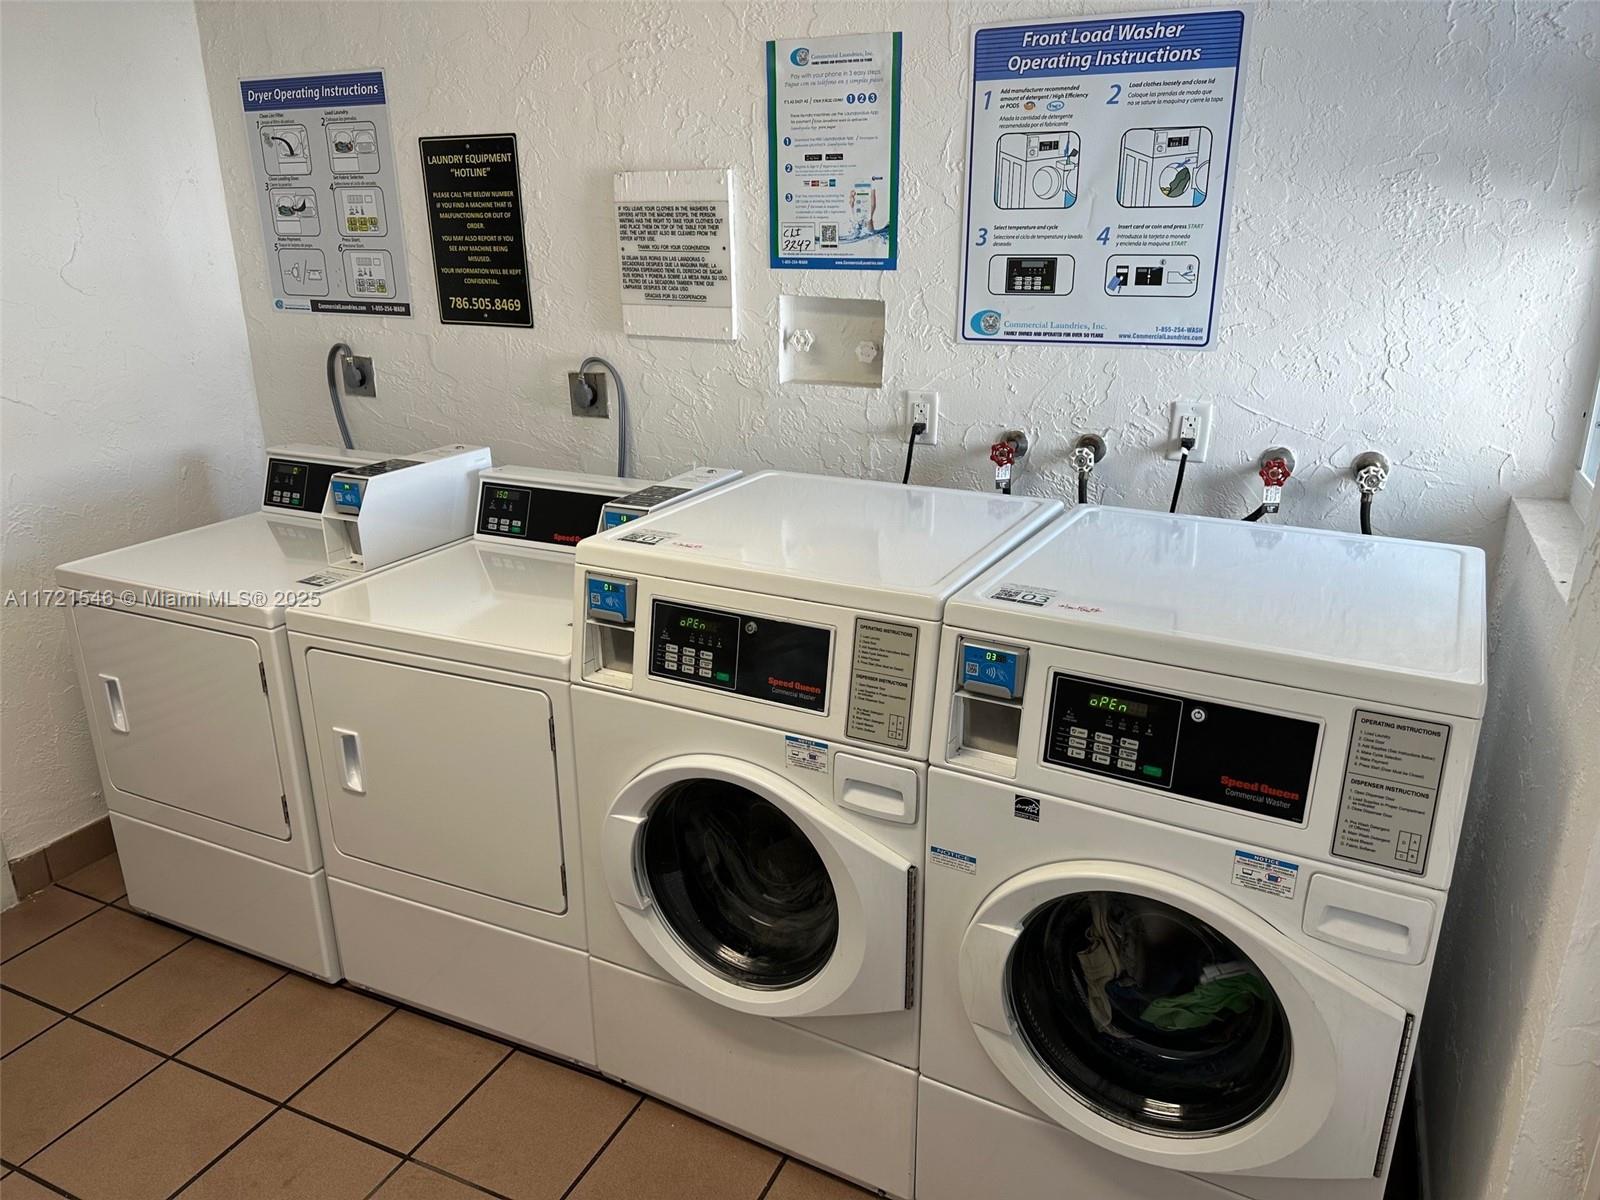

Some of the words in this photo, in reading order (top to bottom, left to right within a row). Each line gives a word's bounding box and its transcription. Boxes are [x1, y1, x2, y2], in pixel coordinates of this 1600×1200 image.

[1022, 31, 1067, 47] Front
[1071, 28, 1112, 44] Load
[1117, 23, 1183, 42] Washer
[1007, 52, 1091, 74] Operating
[1095, 46, 1200, 66] Instructions
[1011, 86, 1043, 94] manufacturer
[1044, 84, 1080, 92] recommended
[1162, 80, 1181, 88] loosely
[248, 89, 272, 105] Dryer
[273, 86, 320, 102] Operating
[321, 83, 378, 97] Instructions
[1065, 92, 1088, 100] Efficiency
[1105, 83, 1122, 104] 2
[984, 90, 992, 110] 1
[320, 117, 325, 127] 2
[427, 154, 463, 165] LAUNDRY
[465, 153, 511, 164] EQUIPMENT
[450, 168, 491, 177] "HOTLINE"
[265, 182, 269, 191] 3
[329, 183, 334, 191] 4
[975, 228, 987, 246] 3
[1096, 226, 1110, 246] 4
[274, 243, 279, 252] 5
[338, 243, 342, 252] 6
[449, 296, 521, 311] 786.505.8469
[1003, 320, 1049, 329] Commercial
[1050, 321, 1090, 330] Laundries,
[1092, 322, 1108, 330] Inc.
[496, 490, 508, 499] 150
[604, 583, 612, 591] 01
[1021, 593, 1050, 603] 03
[860, 624, 882, 633] OPERATING
[883, 629, 913, 638] INSTRUCTIONS
[986, 652, 997, 661] 03
[768, 676, 794, 691] Speed
[796, 680, 821, 695] Queen
[772, 687, 798, 698] Commercial
[799, 692, 817, 701] Washer
[1360, 718, 1395, 729] OPERATING
[1396, 724, 1441, 738] INSTRUCTIONS
[1220, 775, 1258, 793] Speed
[1260, 782, 1299, 801] Queen
[1350, 778, 1384, 790] DISPENSER
[1385, 784, 1429, 799] INSTRUCTIONS
[1225, 787, 1263, 803] Commercial
[1265, 796, 1291, 809] Washer
[937, 848, 970, 861] NOTICE
[1254, 855, 1280, 865] NOTICE
